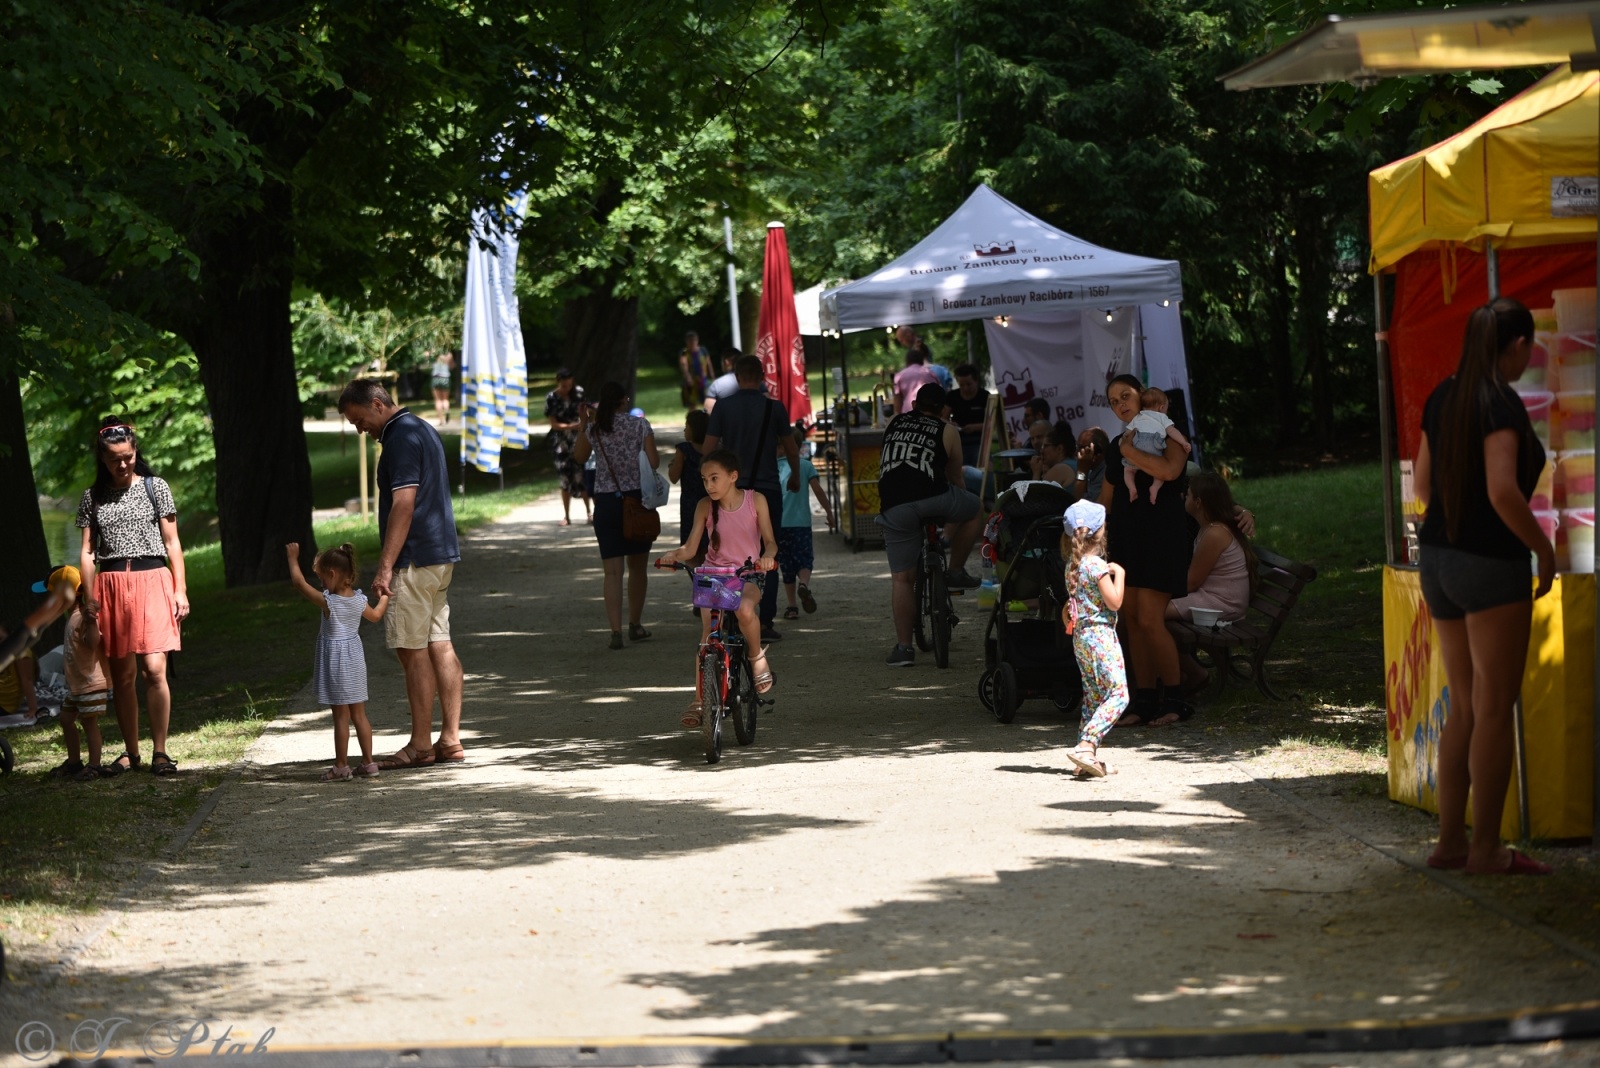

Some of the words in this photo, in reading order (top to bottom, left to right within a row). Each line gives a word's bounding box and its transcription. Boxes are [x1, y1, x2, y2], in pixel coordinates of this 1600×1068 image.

[910, 264, 958, 276] Browar
[963, 256, 1029, 270] Zamkowy
[1033, 252, 1096, 264] Racibórz
[943, 298, 977, 310] Browar
[980, 293, 1026, 307] Zamkowy
[1029, 289, 1074, 303] Racibórz
[1088, 285, 1110, 298] 1567
[1039, 386, 1059, 400] 1567
[891, 431, 927, 445] DARTH
[880, 441, 936, 482] ADER
